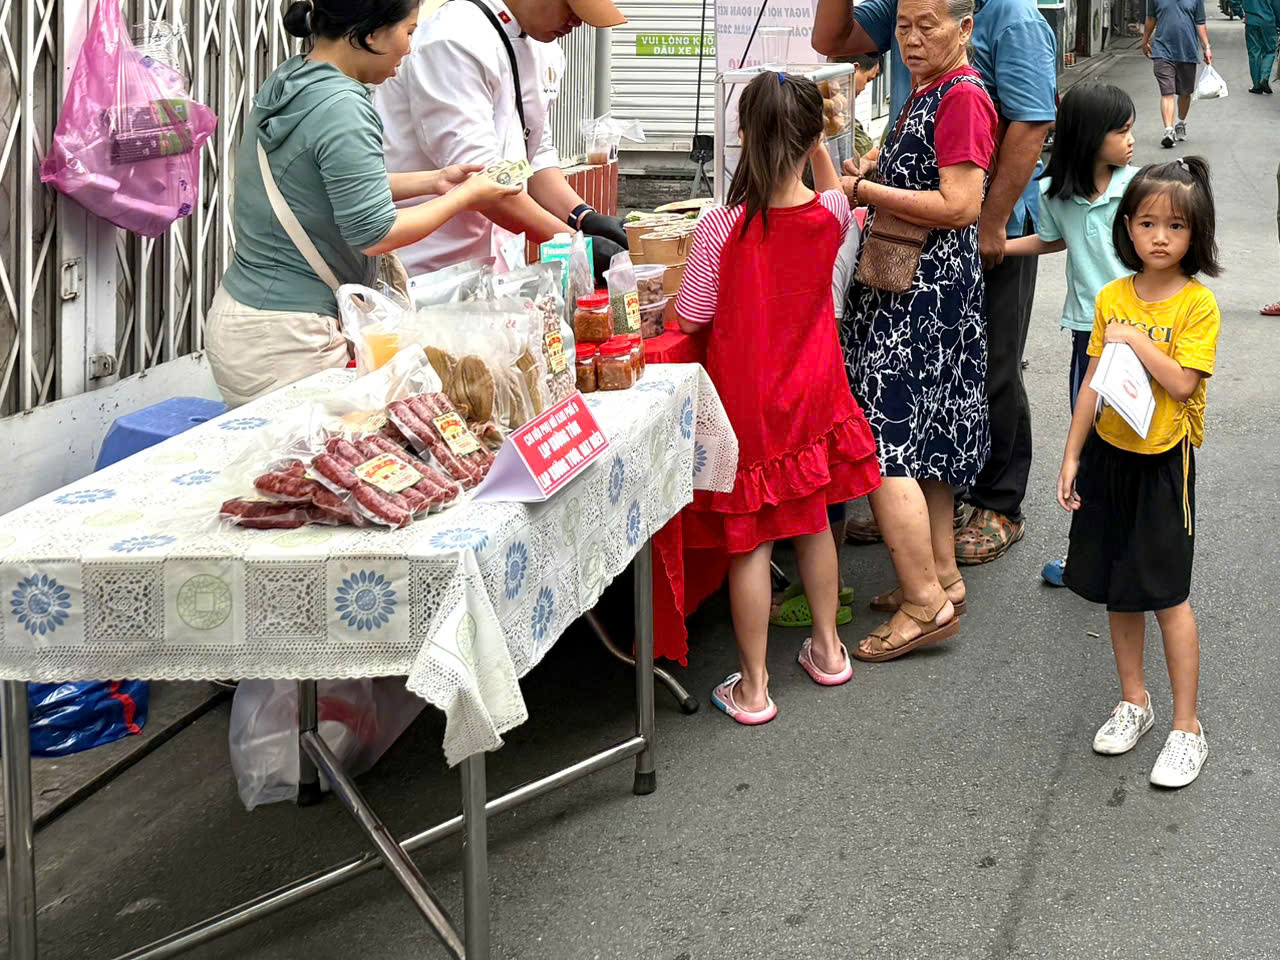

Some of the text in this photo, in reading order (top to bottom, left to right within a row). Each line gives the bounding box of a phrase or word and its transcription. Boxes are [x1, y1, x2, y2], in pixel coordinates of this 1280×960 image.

[641, 36, 659, 45] VUI
[661, 35, 690, 45] LÒNG
[678, 46, 692, 55] XE
